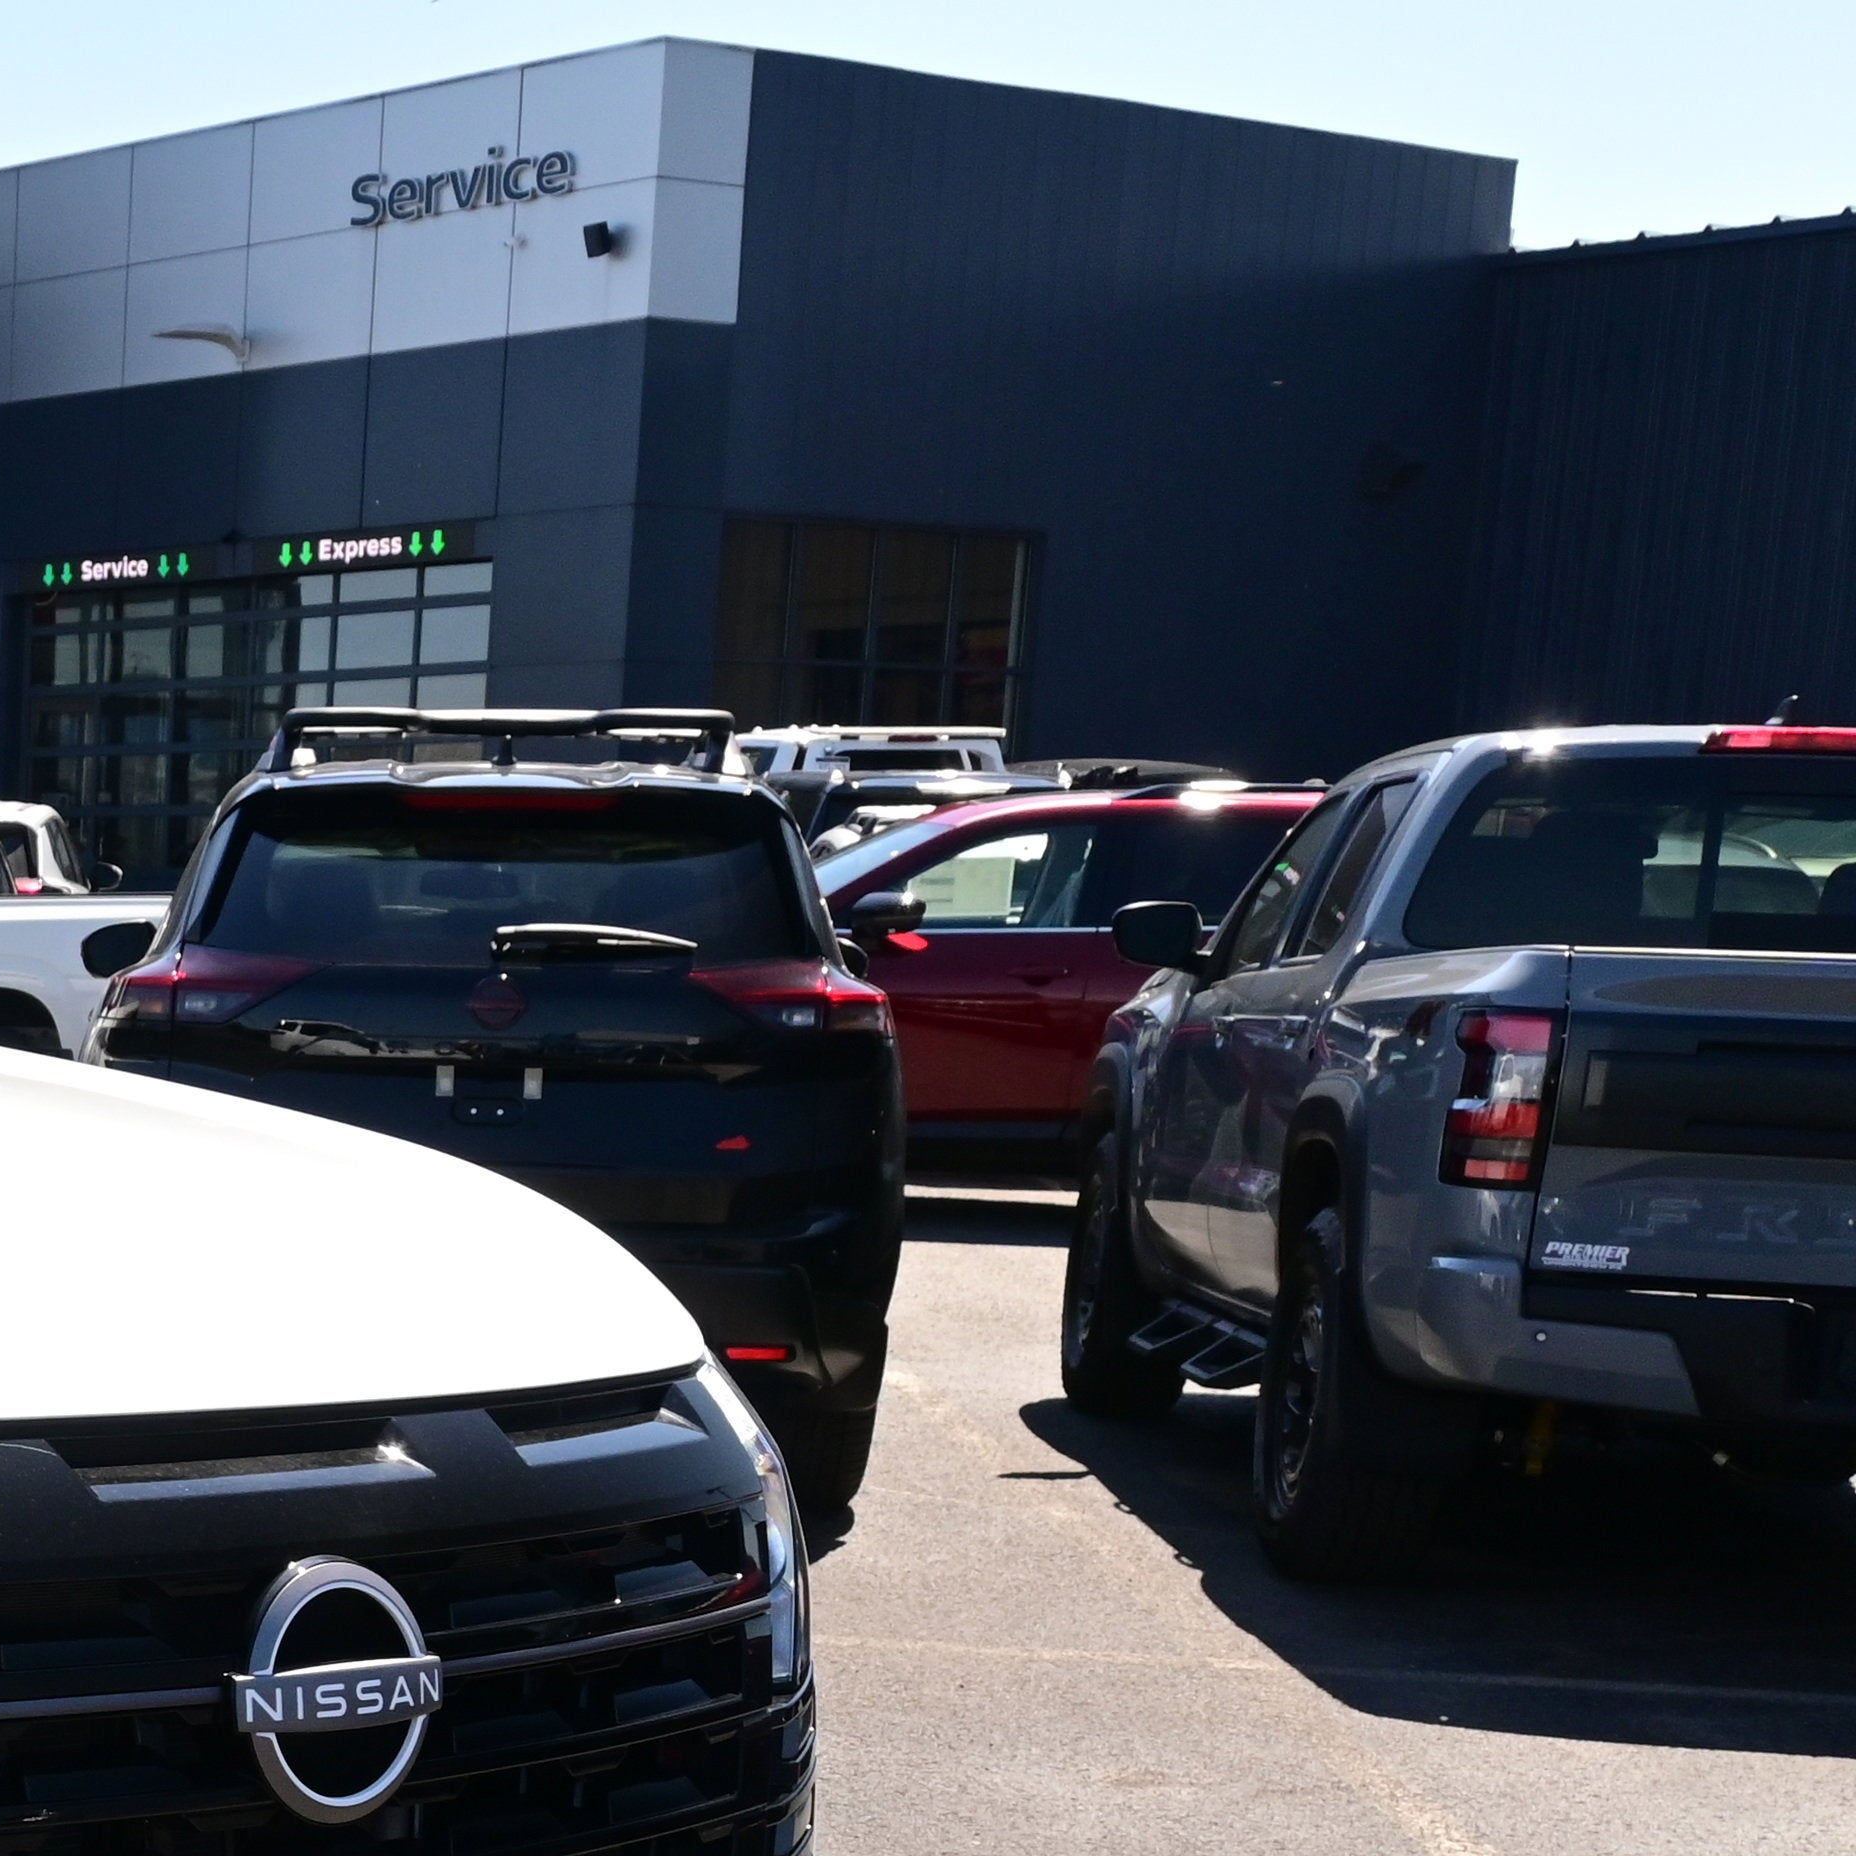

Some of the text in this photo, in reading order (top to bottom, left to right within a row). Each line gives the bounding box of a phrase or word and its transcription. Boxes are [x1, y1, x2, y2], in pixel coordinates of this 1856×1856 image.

[350, 145, 576, 228] Service
[318, 536, 403, 565] Express
[81, 555, 149, 582] Service
[1544, 1241, 1631, 1261] PREMIER
[245, 1668, 439, 1723] NISSAN
